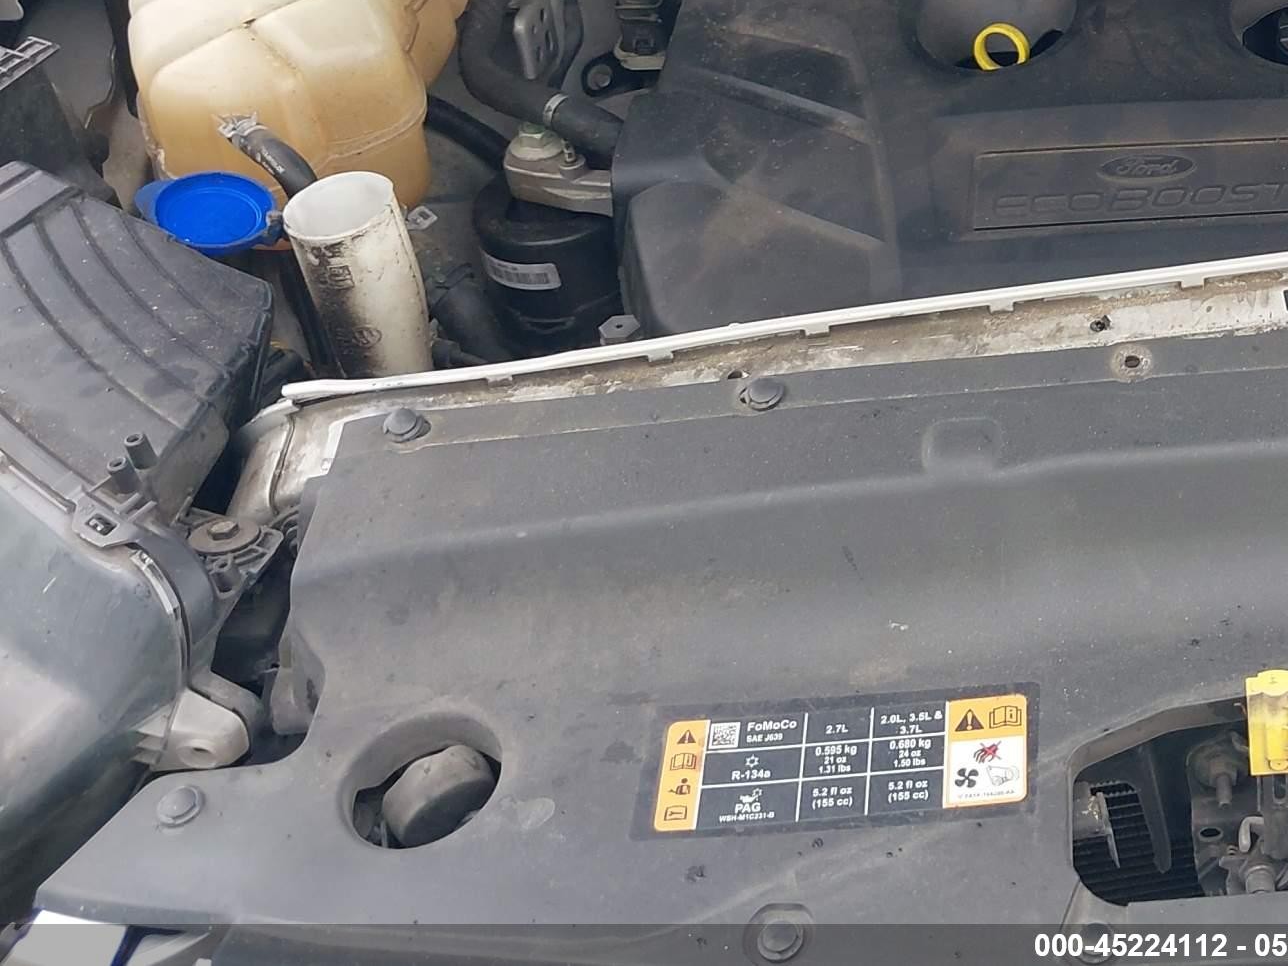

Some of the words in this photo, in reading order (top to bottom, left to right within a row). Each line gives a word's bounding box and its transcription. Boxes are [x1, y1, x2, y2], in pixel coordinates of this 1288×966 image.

[1115, 157, 1178, 177] Ford
[880, 715, 906, 725] 2.0L,
[934, 710, 943, 719] &
[747, 719, 797, 732] FoMoCo
[826, 725, 848, 734] 2.7L
[900, 724, 922, 734] 3.7L
[746, 734, 763, 743] SAE
[889, 740, 916, 749] 0.680
[919, 738, 931, 749] kg
[815, 746, 842, 756] 0.595
[845, 745, 857, 755] kg
[899, 750, 909, 758] 24
[913, 758, 926, 766] lbs
[819, 766, 836, 774] 1.31
[838, 764, 851, 772] lbs
[731, 769, 771, 781] R-134a
[830, 787, 838, 795] fl
[840, 787, 852, 795] oz
[888, 781, 903, 791] 5.2
[906, 780, 913, 789] fl
[915, 780, 928, 788] oz
[888, 792, 911, 803] (155
[912, 790, 929, 800] cc)
[734, 802, 761, 814] PAG
[812, 799, 835, 810] (155
[836, 797, 853, 807] cc)
